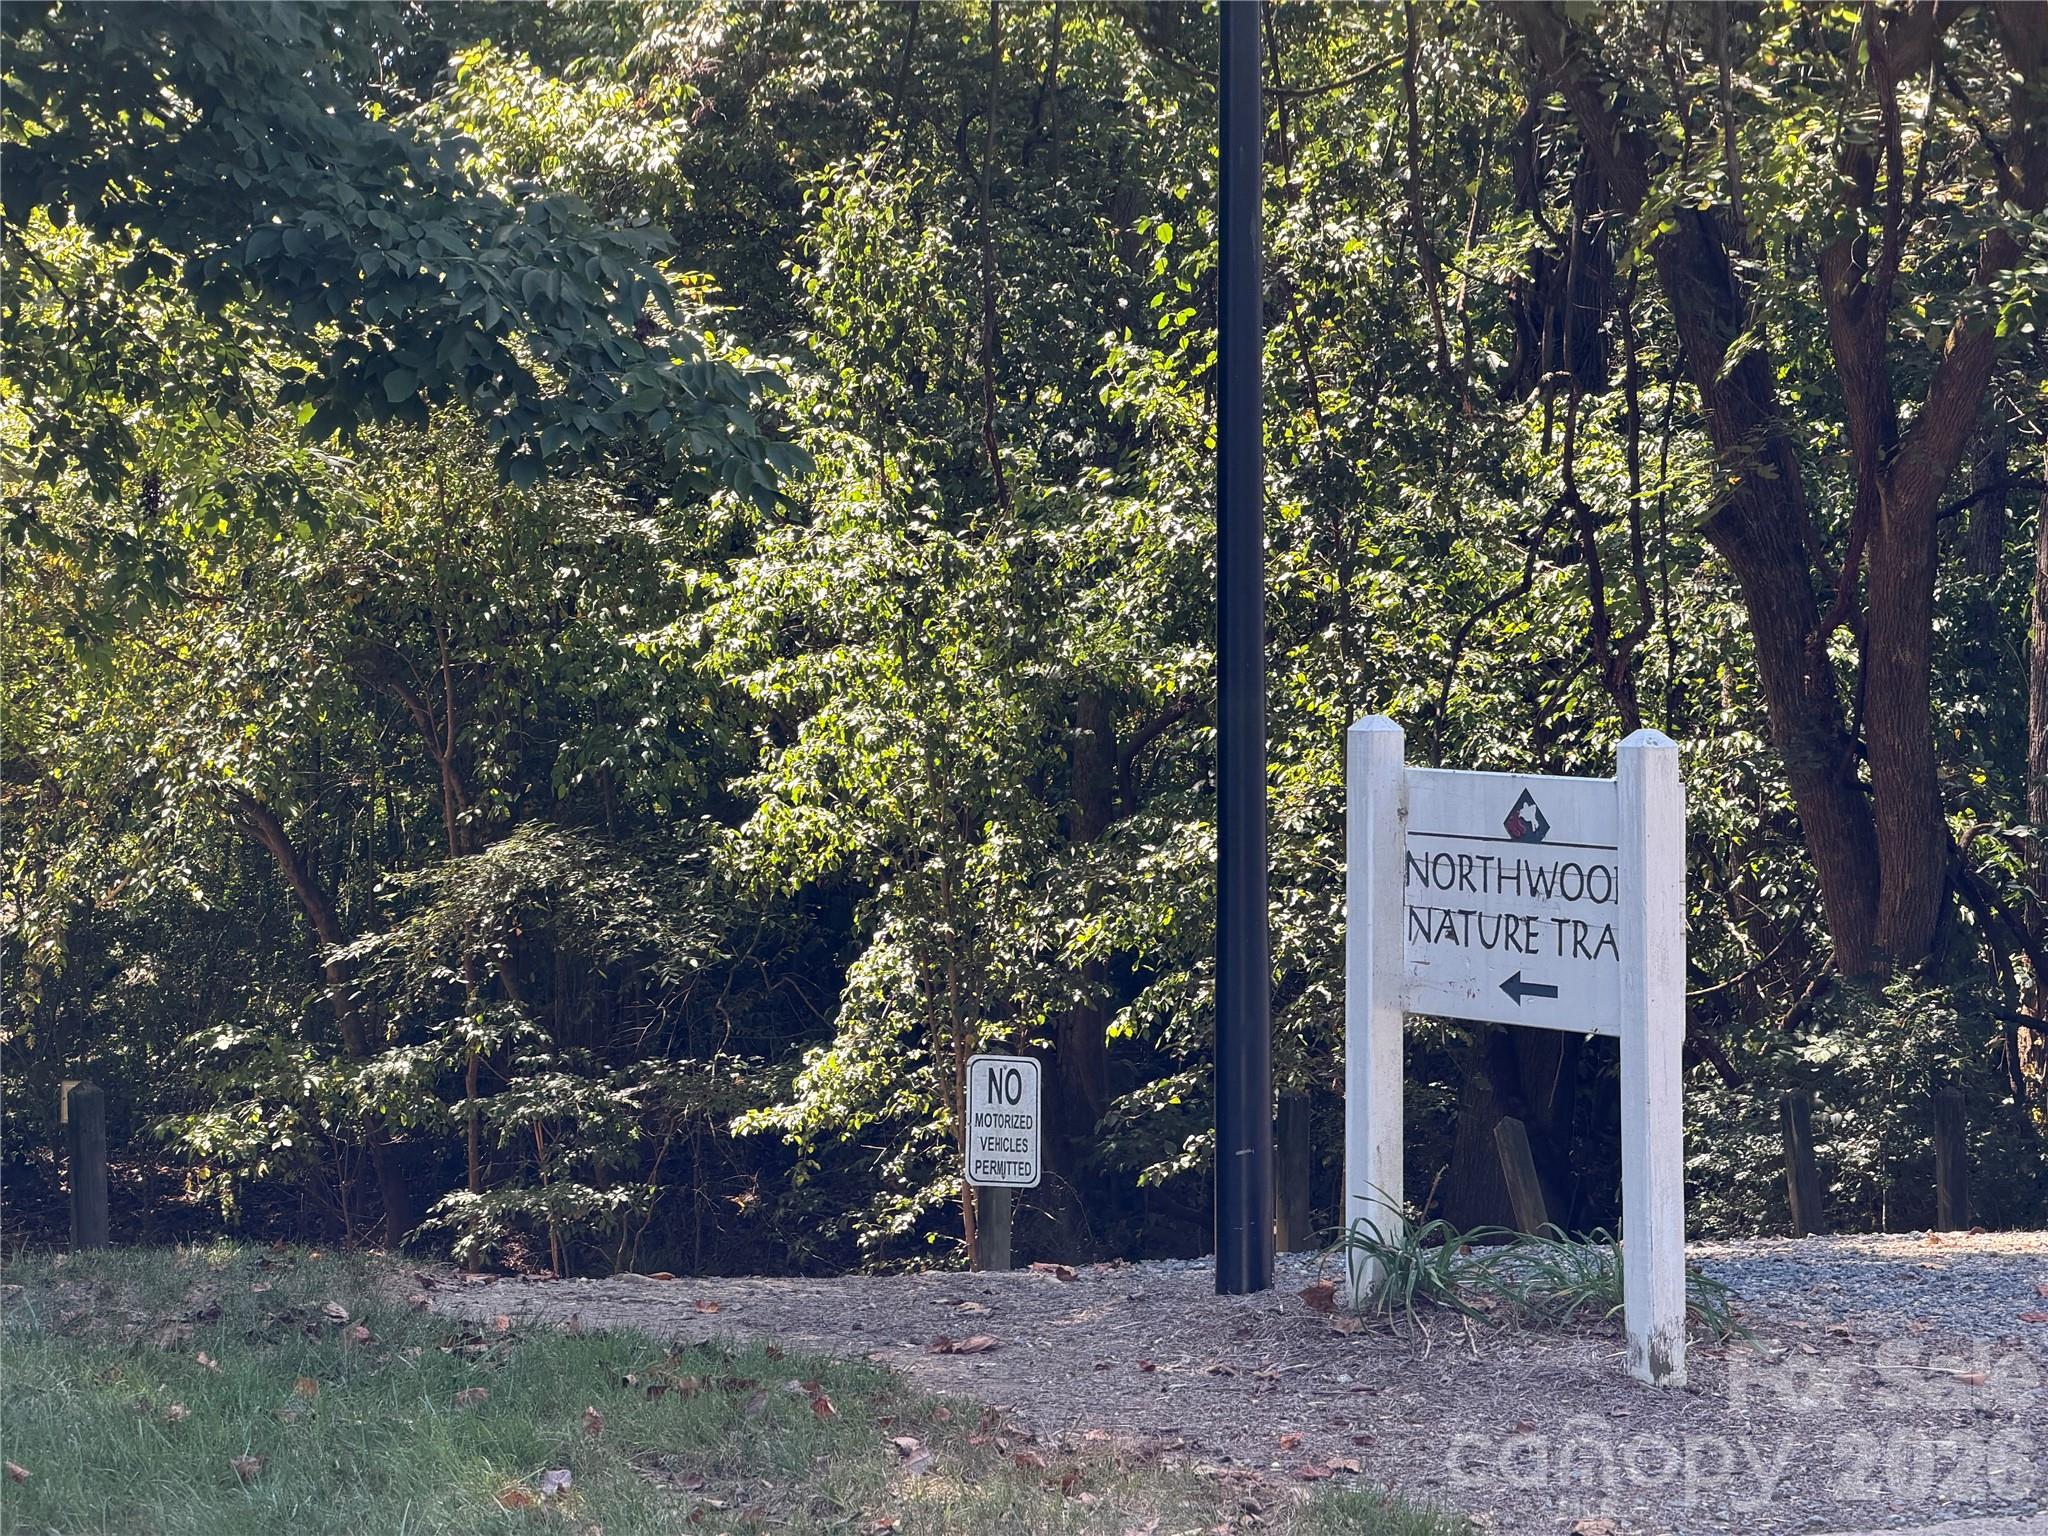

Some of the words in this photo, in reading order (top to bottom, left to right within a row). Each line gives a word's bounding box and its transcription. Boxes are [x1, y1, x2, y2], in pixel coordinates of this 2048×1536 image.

[1408, 905, 1539, 954] NATURE
[988, 1067, 1022, 1106] NO
[974, 1113, 1033, 1130] MOTORIZED
[980, 1136, 1029, 1153] VEHICLES
[975, 1160, 1032, 1177] PERMITTED
